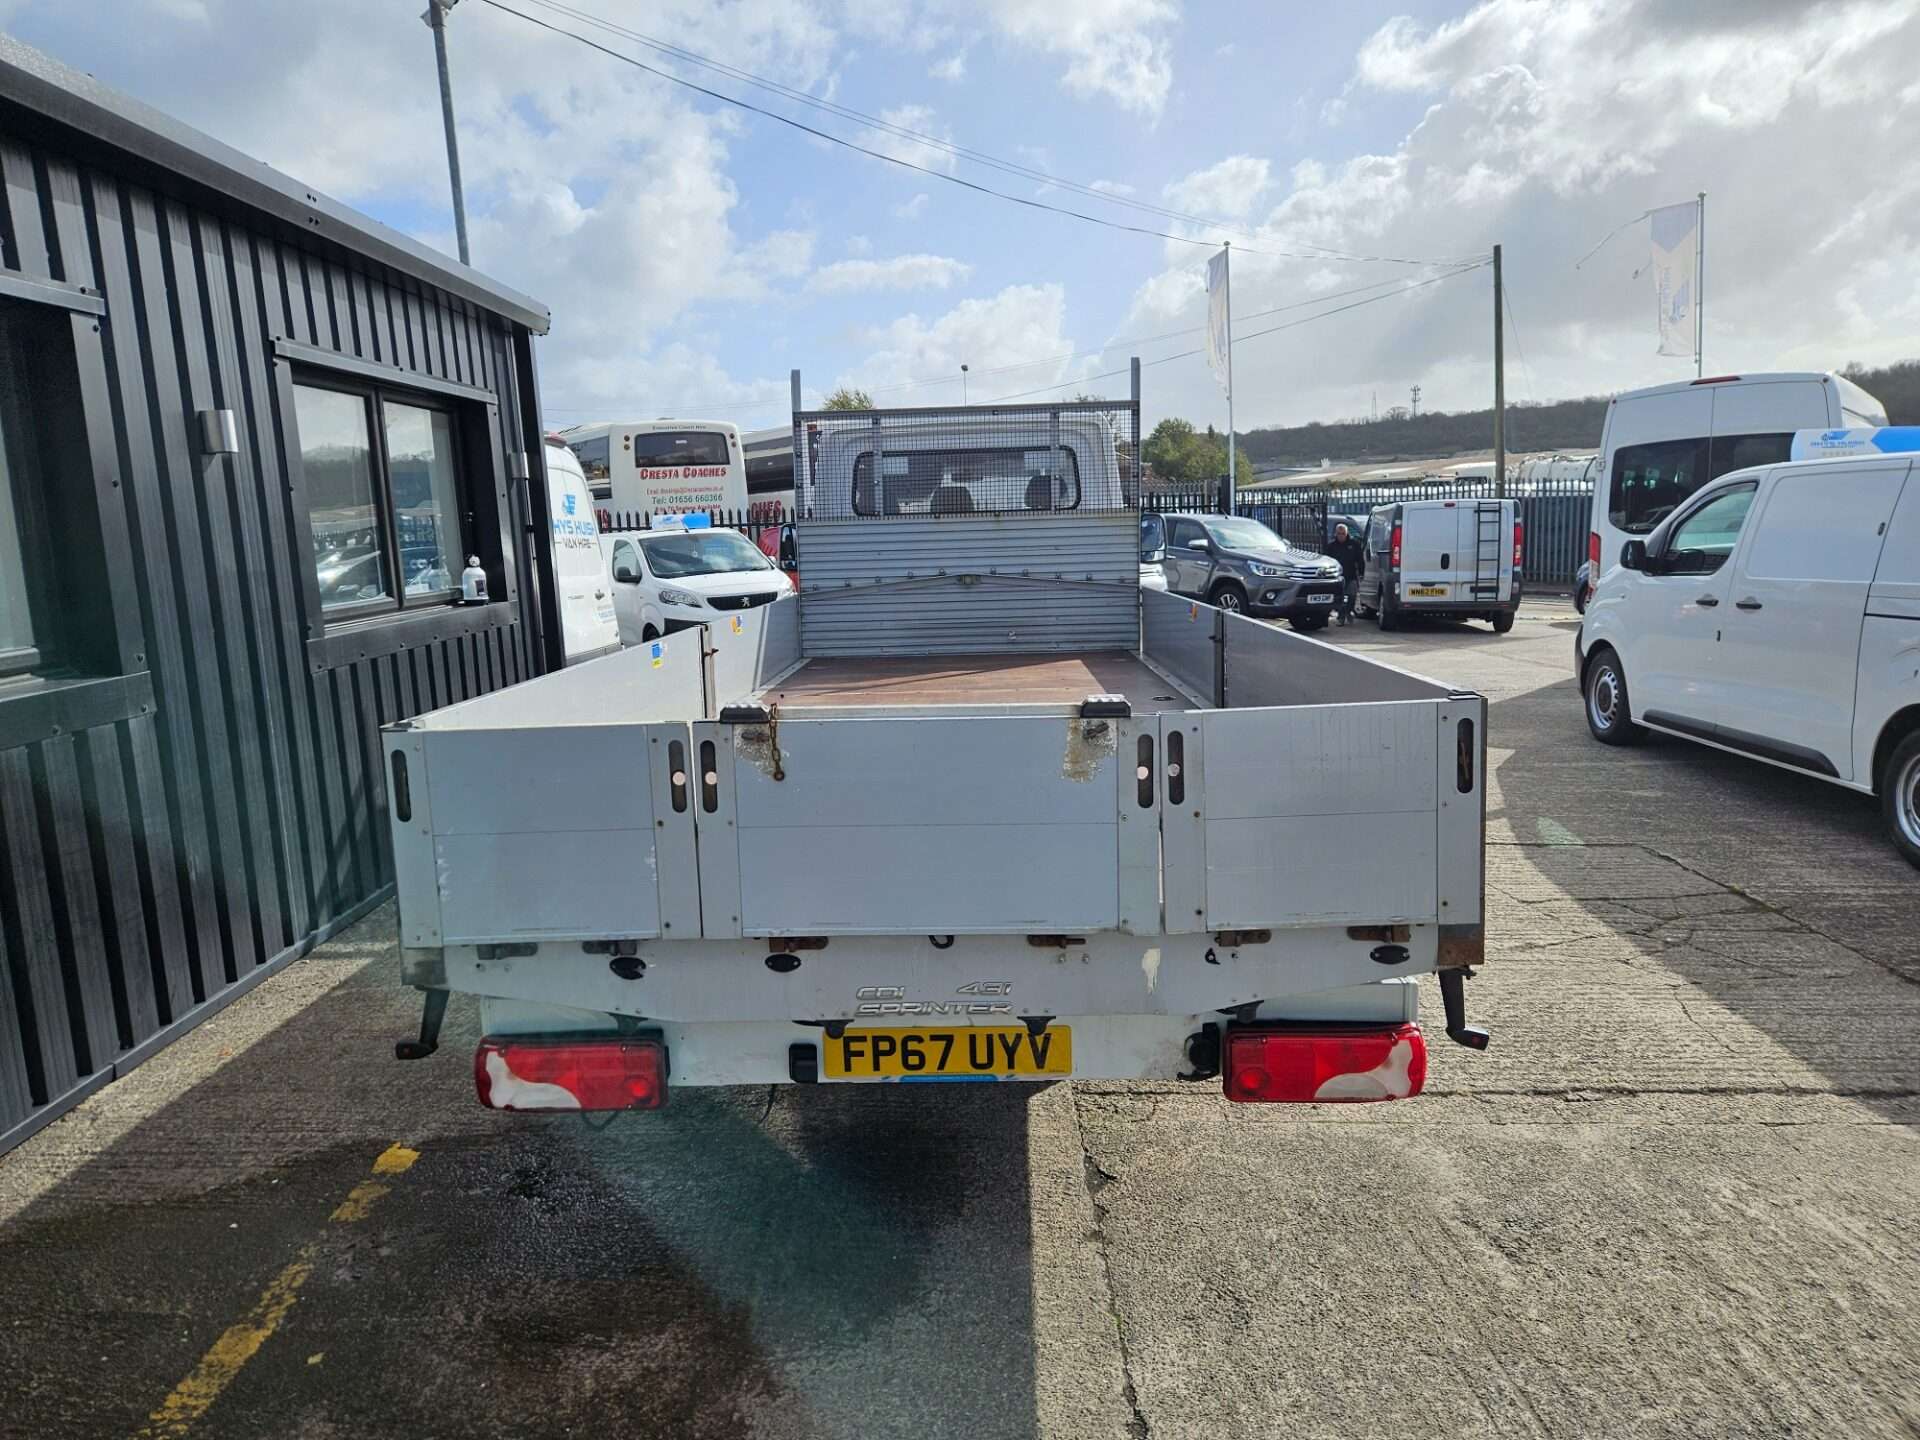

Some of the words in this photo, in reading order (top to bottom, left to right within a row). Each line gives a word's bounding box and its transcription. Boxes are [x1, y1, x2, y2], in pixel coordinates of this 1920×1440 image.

[640, 468, 680, 480] CRESTA
[682, 467, 727, 479] COACHES
[856, 986, 904, 1000] CDI
[854, 1001, 1016, 1018] SPRINTER
[842, 1034, 955, 1073] FP67
[968, 1032, 1053, 1071] UYV
